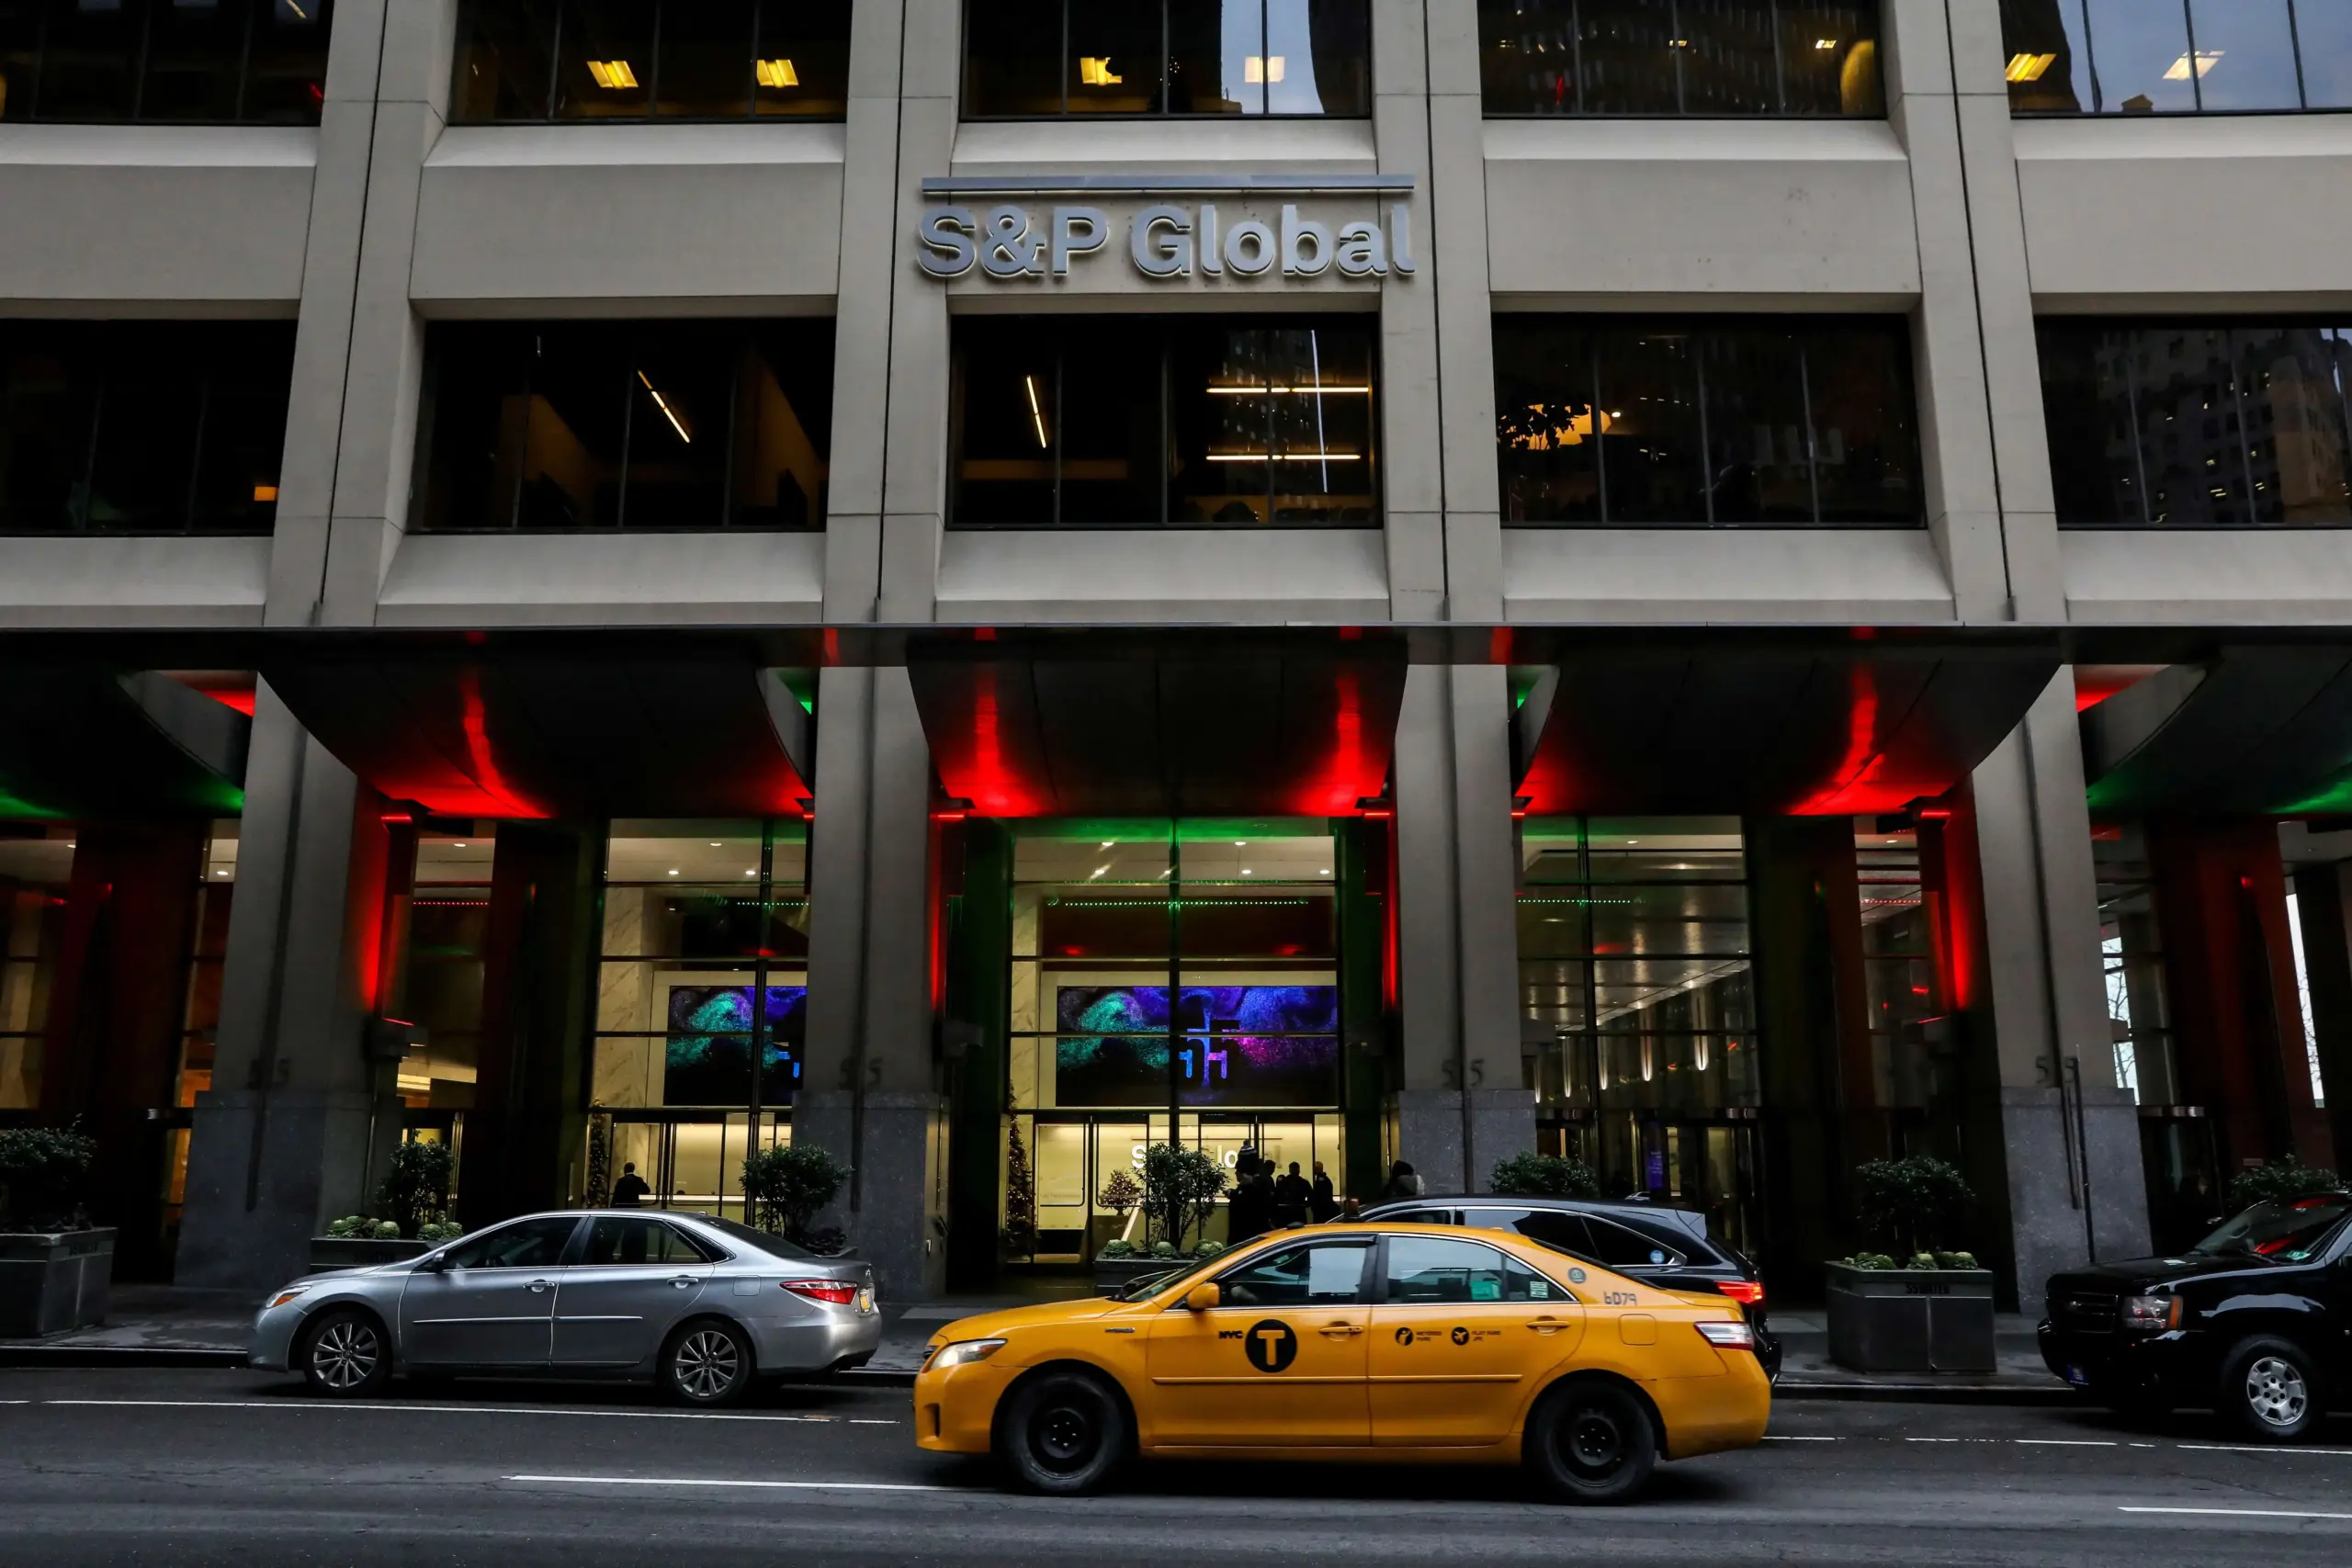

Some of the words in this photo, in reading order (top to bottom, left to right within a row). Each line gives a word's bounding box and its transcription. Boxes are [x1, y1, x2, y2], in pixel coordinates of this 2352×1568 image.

[919, 204, 1108, 276] S&P
[1131, 203, 1416, 276] Global
[1218, 1330, 1243, 1339] NYC
[1257, 1329, 1285, 1366] T
